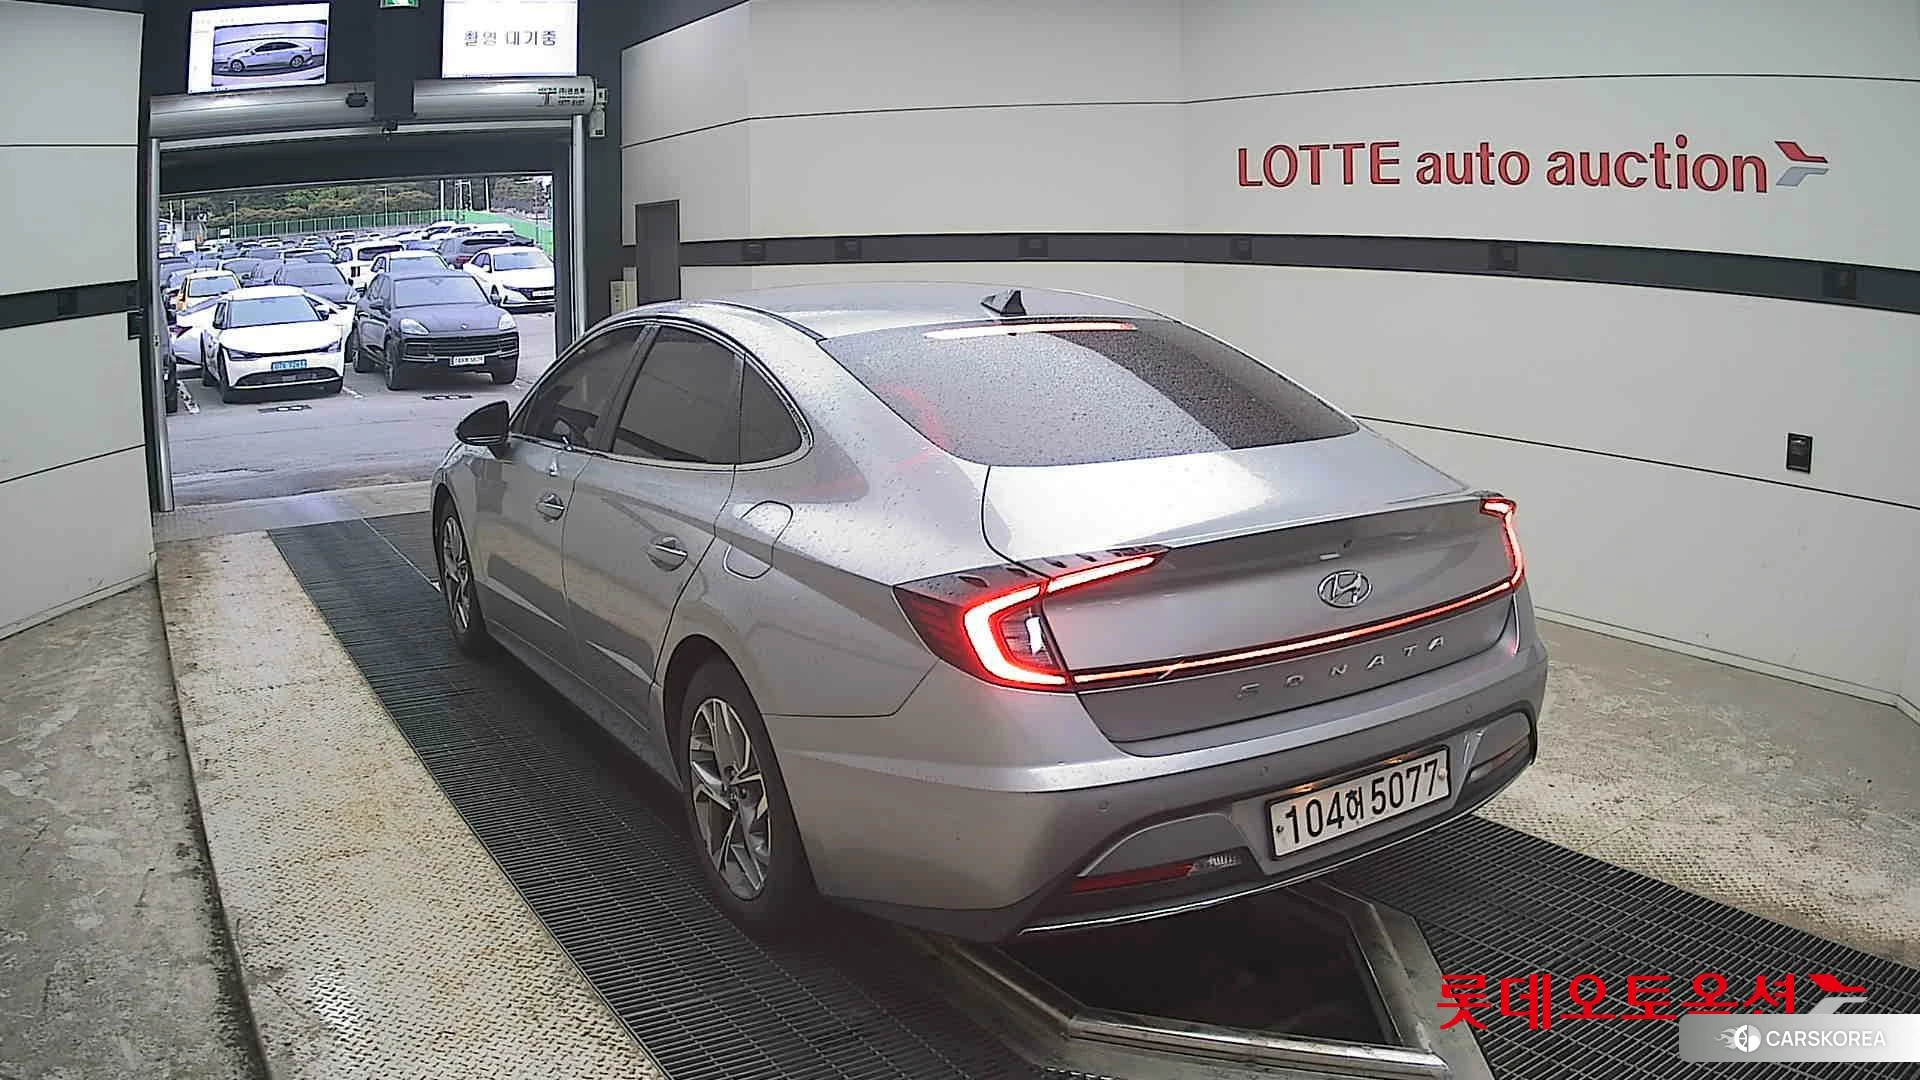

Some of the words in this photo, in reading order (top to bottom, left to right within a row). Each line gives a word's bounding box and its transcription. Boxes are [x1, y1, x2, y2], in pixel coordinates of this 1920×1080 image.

[505, 30, 556, 47] 대기중
[1237, 141, 1400, 188] LOTTE
[1415, 142, 1531, 186] auto
[1546, 134, 1767, 193] auction
